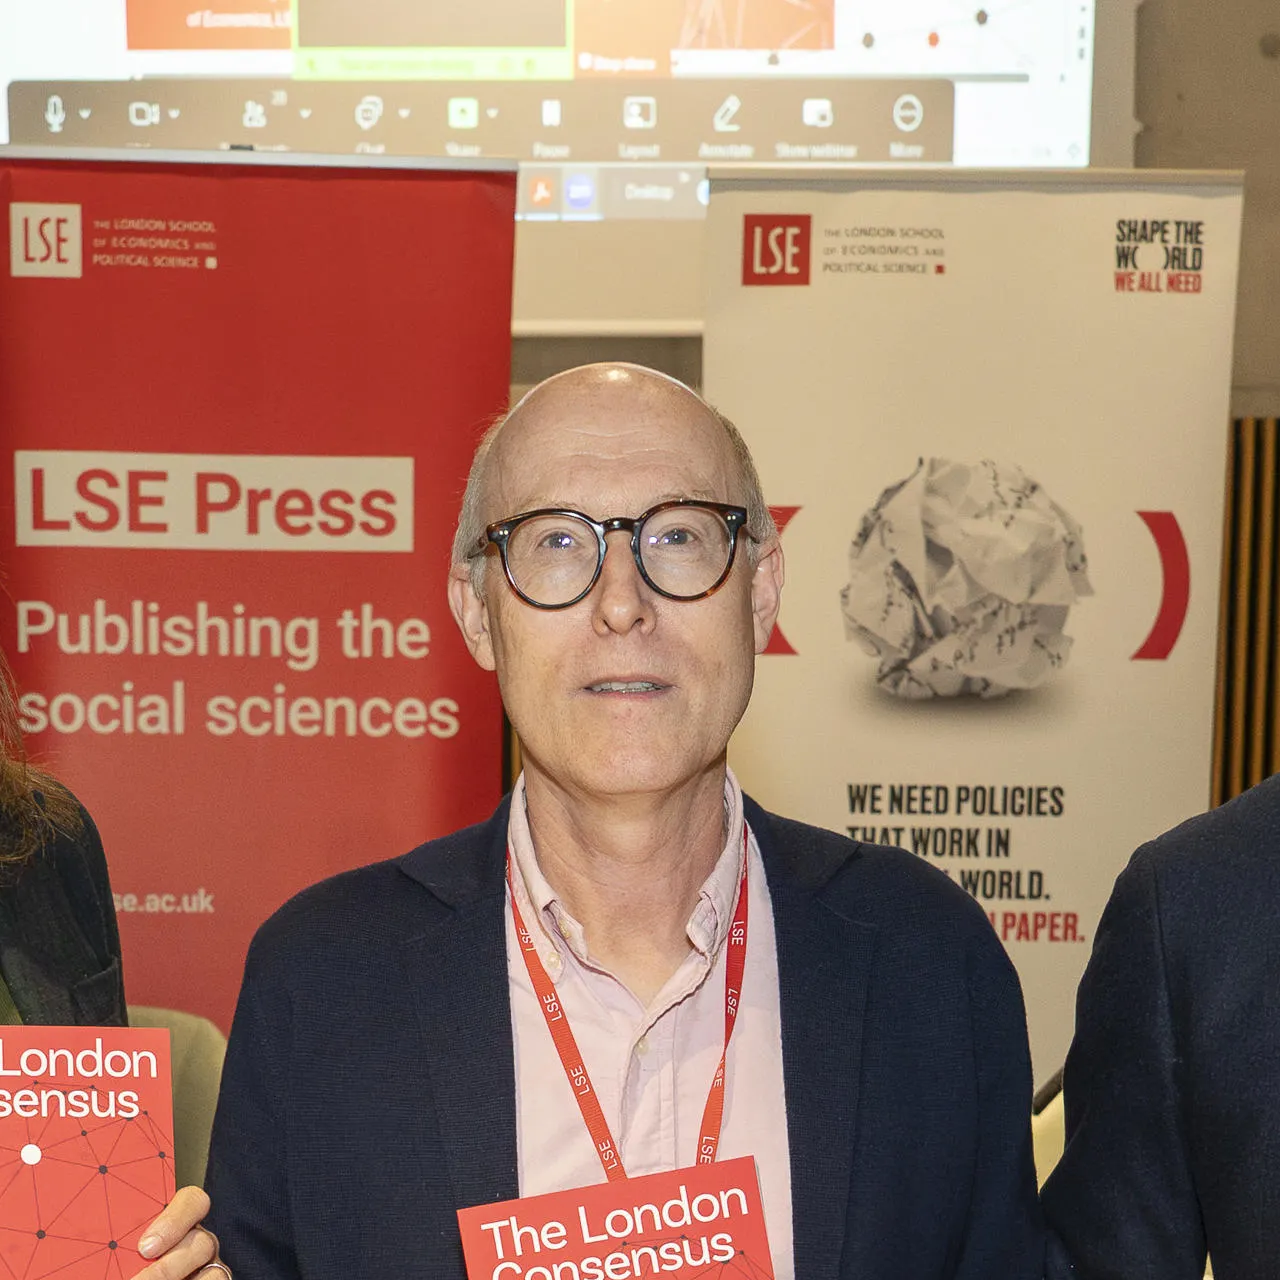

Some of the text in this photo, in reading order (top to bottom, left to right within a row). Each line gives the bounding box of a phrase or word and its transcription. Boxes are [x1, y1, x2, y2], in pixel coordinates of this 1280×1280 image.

[23, 217, 69, 263] LSE
[113, 219, 166, 231] LONDON
[168, 220, 217, 233] SCHOOL
[844, 228, 898, 239] LONDON
[899, 228, 945, 239] SCHOOL
[1116, 219, 1204, 245] SHAPE THE
[111, 236, 190, 250] ECONOMICS
[752, 226, 801, 274] LSE
[841, 245, 919, 257] ECONOMICS
[92, 254, 200, 268] POLITICAL SCIENCE
[822, 263, 880, 274] POLITICAL
[1114, 272, 1202, 294] WE ALL NEED
[30, 467, 398, 538] LSE Press
[17, 598, 431, 672] Publishing the
[19, 680, 460, 739] social sciences
[847, 784, 1065, 818] WE NEED POLICIES
[911, 828, 980, 858] WORK
[986, 829, 1010, 859] IN
[960, 869, 1051, 901] WORLD.
[731, 920, 745, 946] LSE
[1002, 912, 1086, 943] PAPER.
[543, 992, 563, 1021] LSE
[727, 988, 739, 1017] LSE
[570, 1064, 591, 1096] LSE
[598, 1139, 617, 1170] LSE
[700, 1135, 716, 1164] LSE
[481, 1185, 749, 1259] The London
